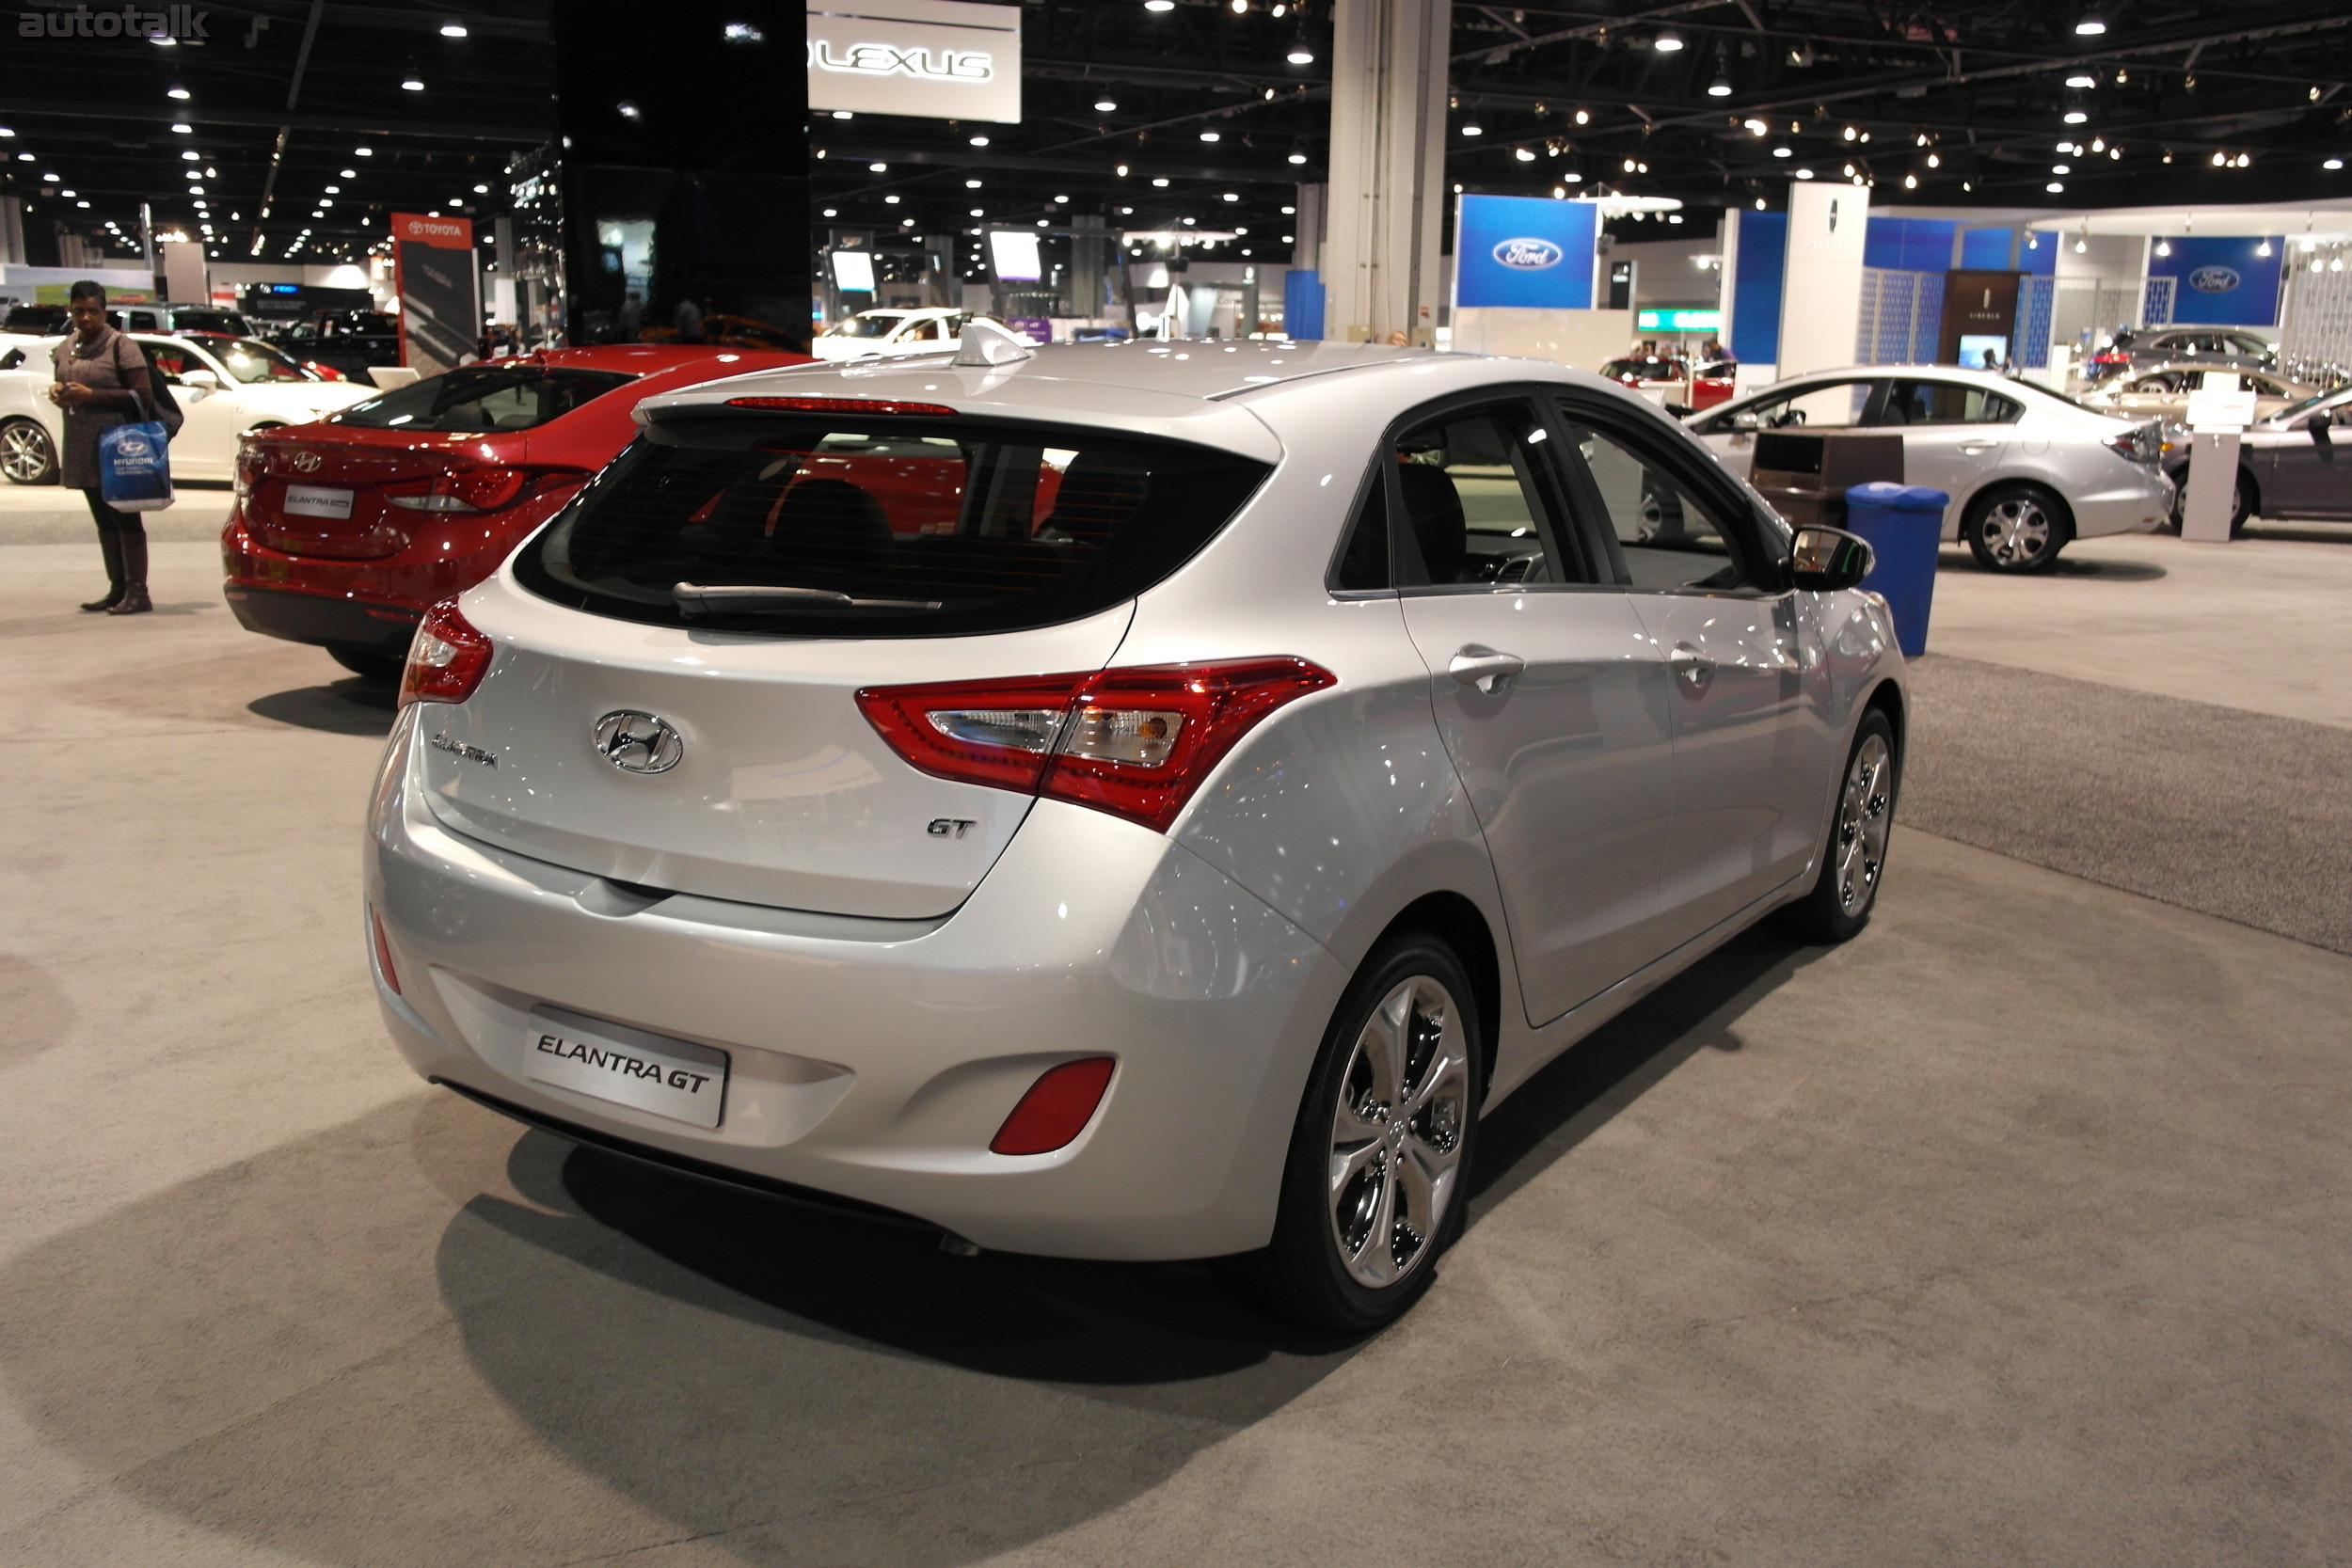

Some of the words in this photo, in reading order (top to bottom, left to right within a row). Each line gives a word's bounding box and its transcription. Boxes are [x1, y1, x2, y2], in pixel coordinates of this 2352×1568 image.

[818, 42, 992, 80] LEXUS
[423, 224, 461, 236] TOYOTA
[287, 495, 328, 506] ELANTRA
[927, 818, 977, 840] GT
[536, 1035, 662, 1085] ELANTRA
[667, 1069, 710, 1094] GT
